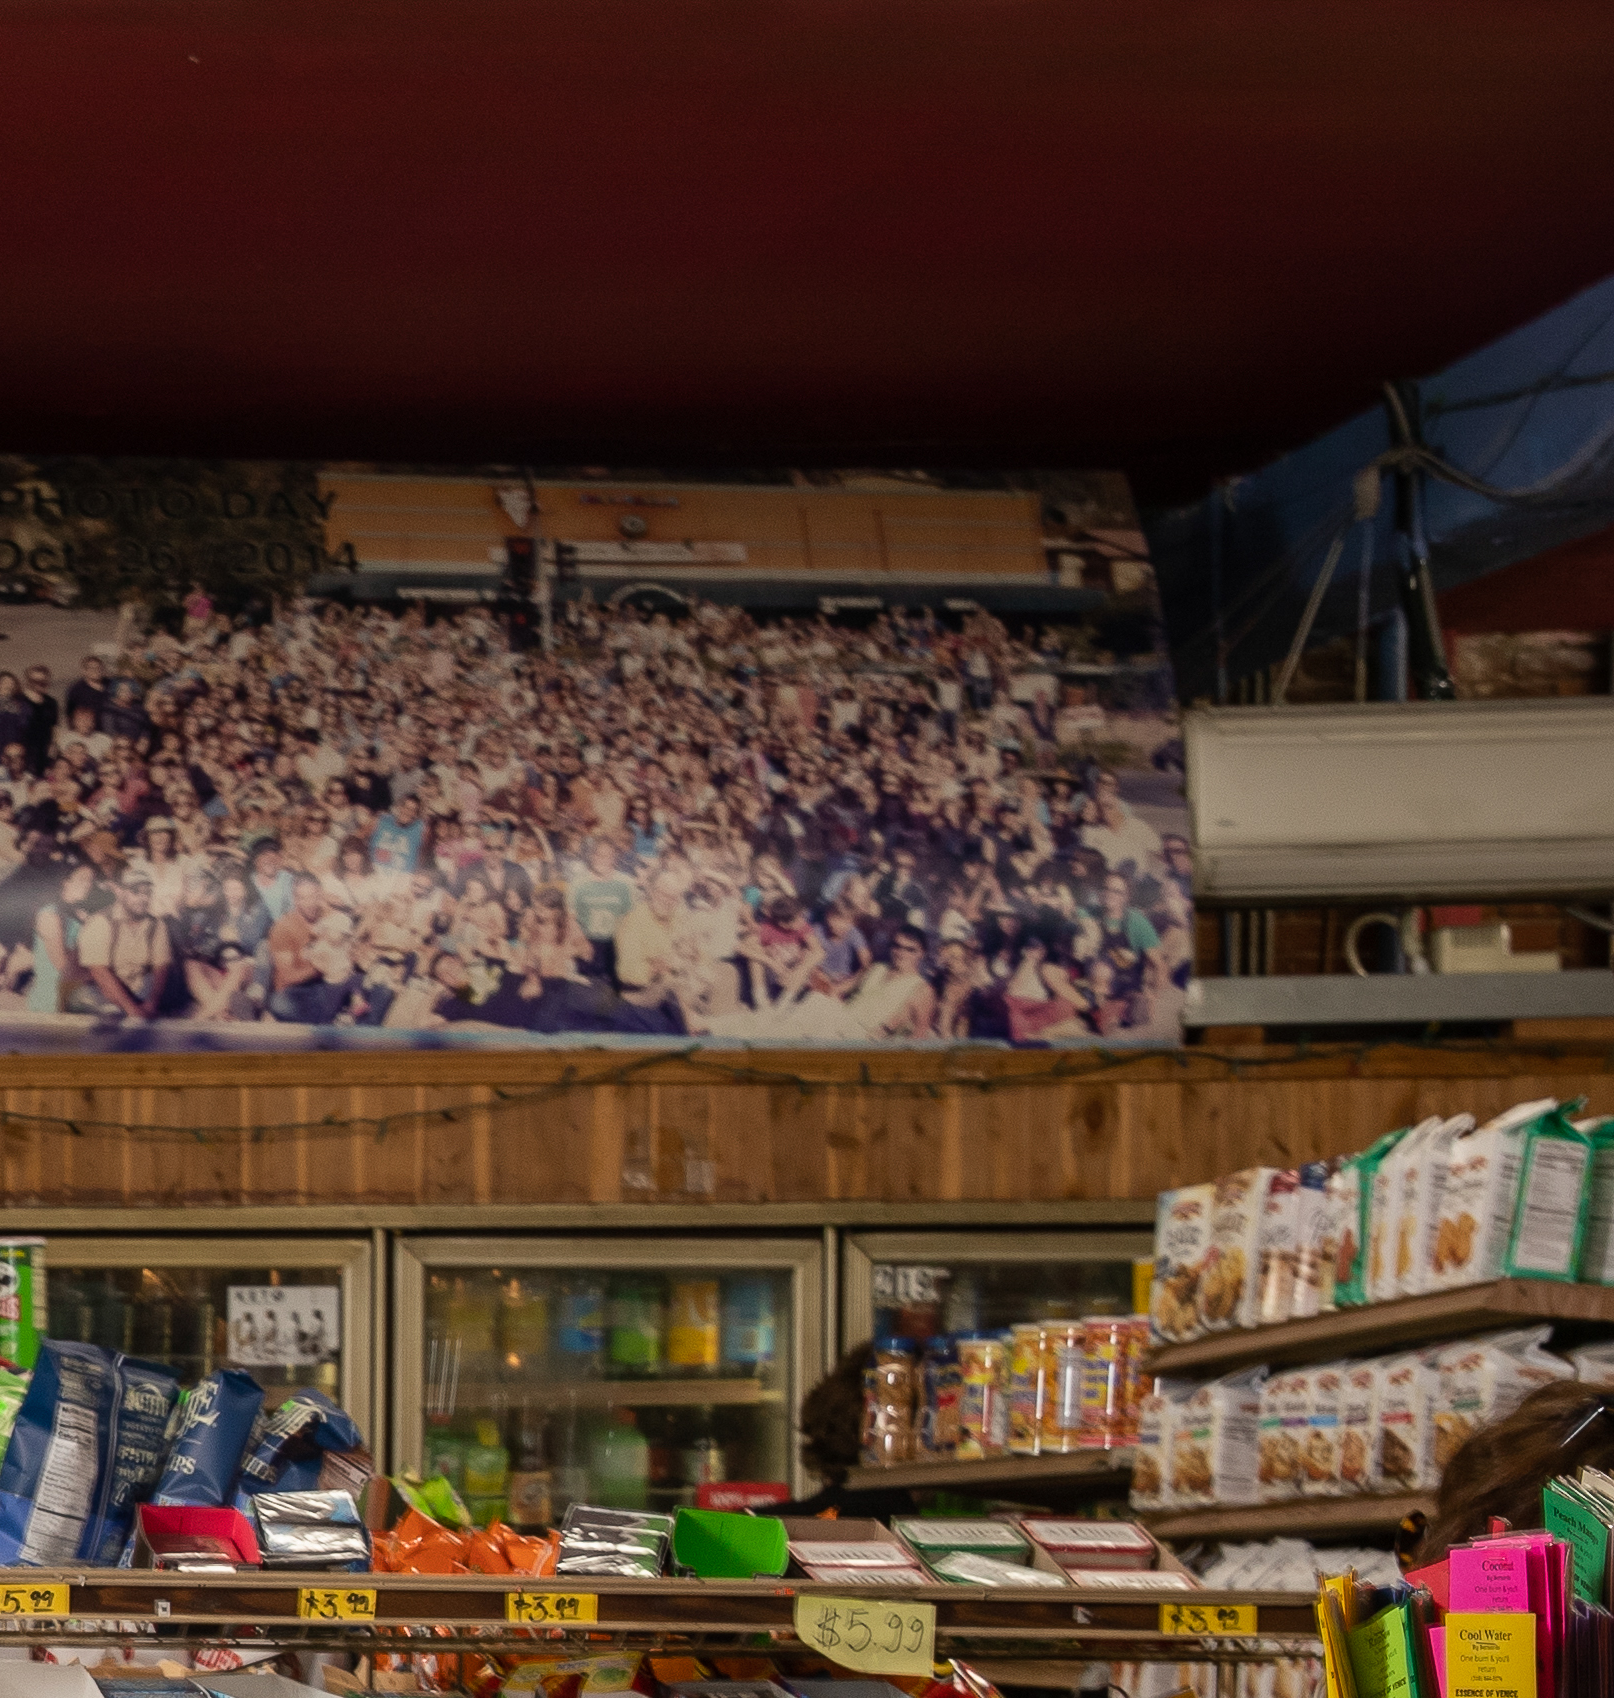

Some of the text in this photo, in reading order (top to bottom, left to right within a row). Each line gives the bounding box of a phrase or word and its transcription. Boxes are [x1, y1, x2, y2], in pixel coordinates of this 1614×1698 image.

[814, 1606, 925, 1654] $5.99
[1460, 1630, 1512, 1641] Cool Water
[1455, 1689, 1518, 1698] ESSENCE OF VENICE
